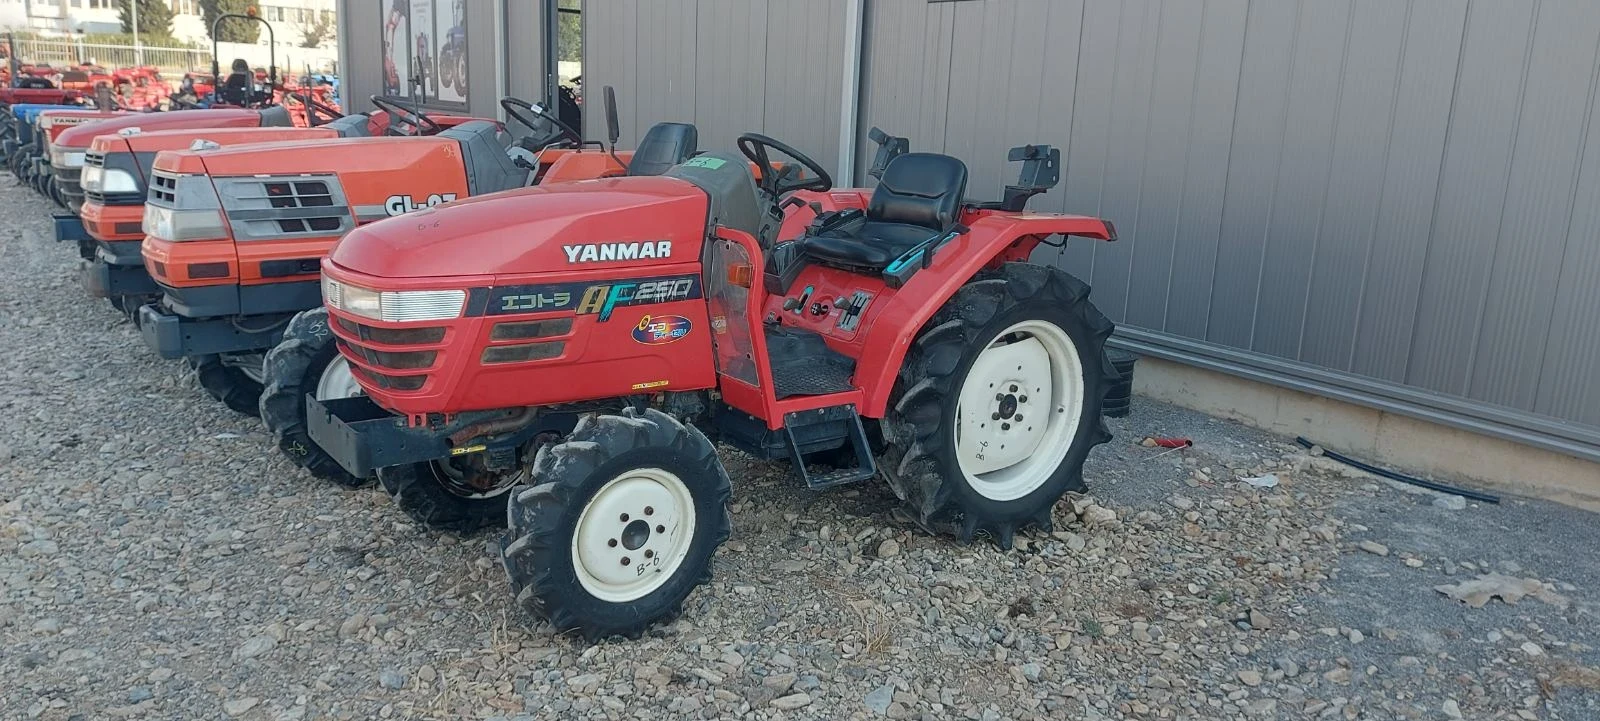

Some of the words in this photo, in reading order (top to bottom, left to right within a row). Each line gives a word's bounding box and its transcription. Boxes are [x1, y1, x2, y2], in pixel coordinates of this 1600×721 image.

[562, 239, 672, 264] YANMAR
[501, 292, 571, 310] エコトラ
[648, 322, 666, 333] エコ
[975, 441, 989, 461] B-6
[636, 551, 660, 577] B-6
